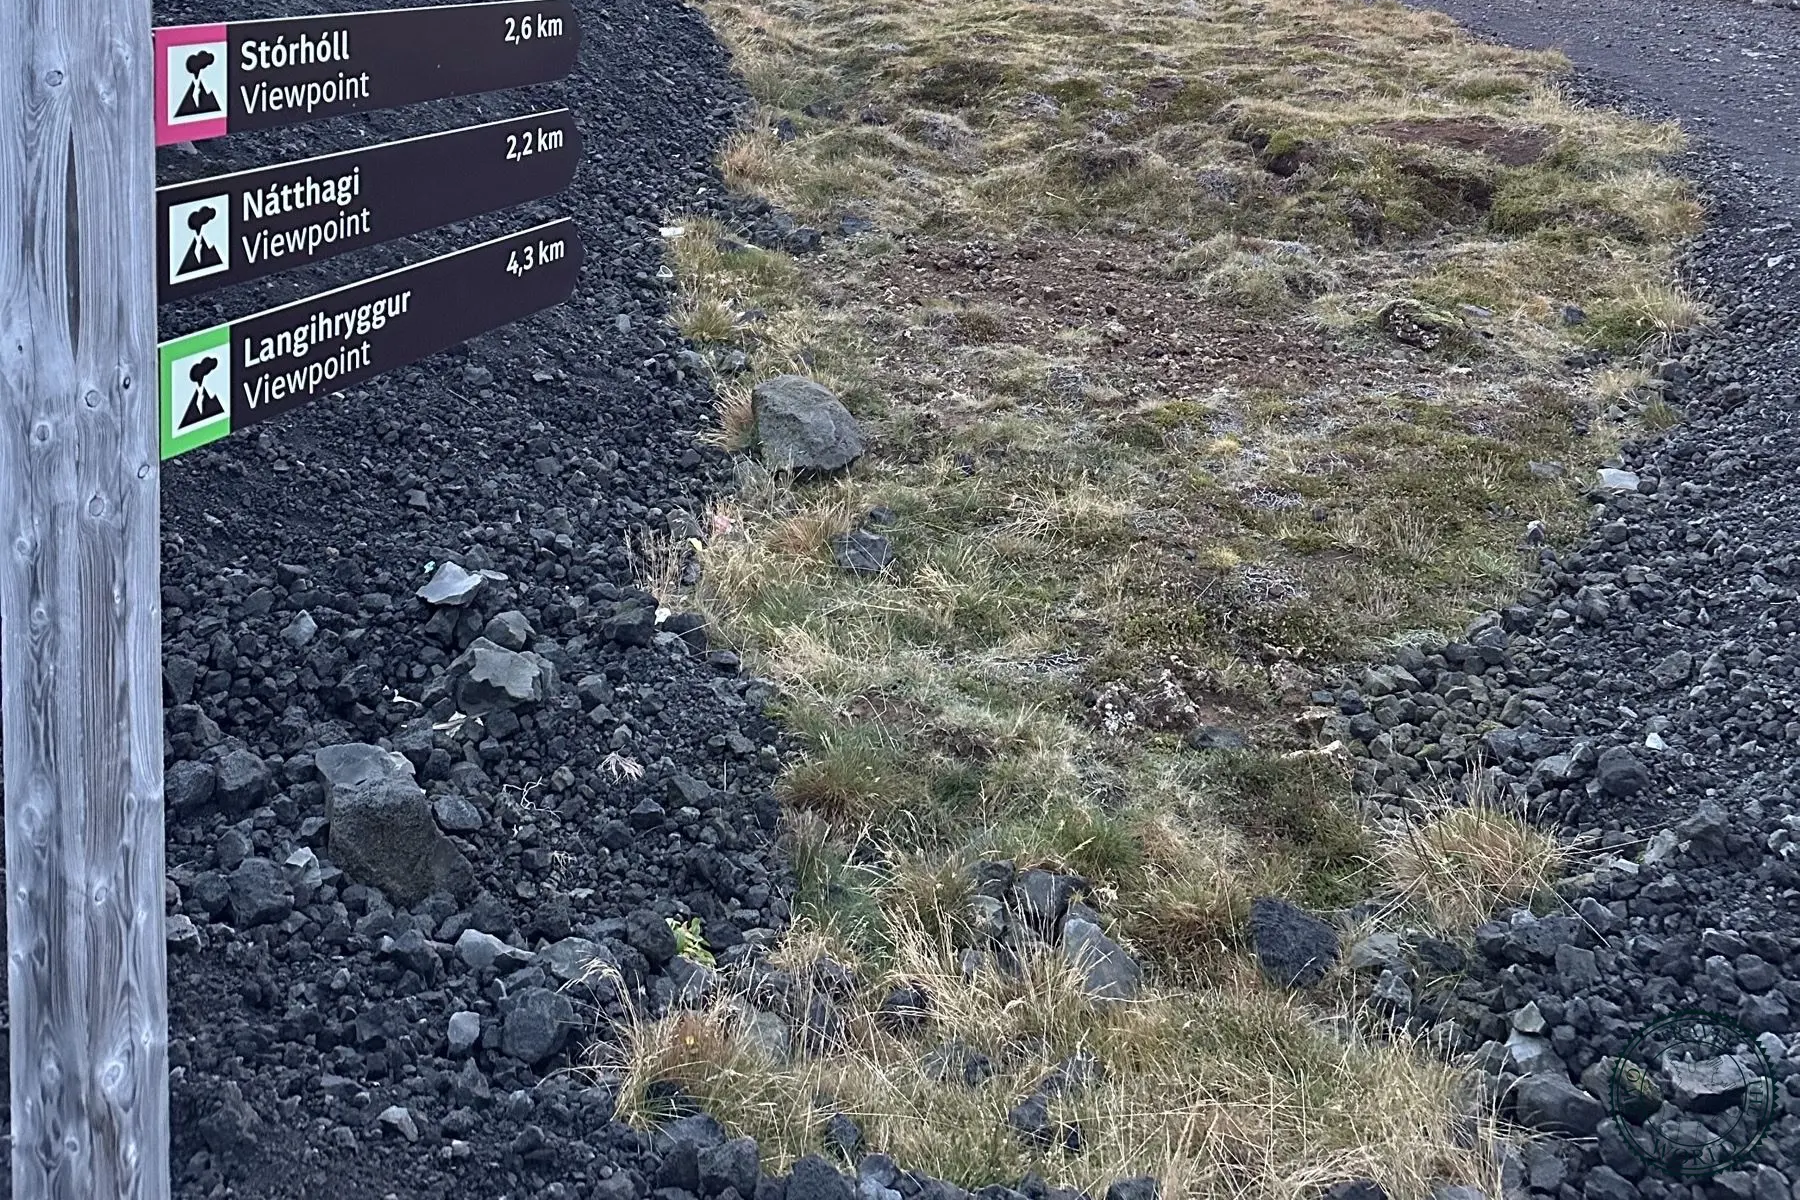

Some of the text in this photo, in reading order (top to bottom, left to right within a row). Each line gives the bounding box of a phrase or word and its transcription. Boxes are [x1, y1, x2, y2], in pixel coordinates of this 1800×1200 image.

[240, 30, 350, 72] Stórhóll
[504, 12, 563, 46] 2,6 km
[240, 71, 370, 115] Viewpoint
[506, 126, 563, 162] 2,2 km
[242, 166, 360, 222] Nátthagi
[242, 205, 371, 264] Viewpoint
[506, 239, 564, 278] 4,3 km
[244, 289, 412, 368] Langihryggur
[243, 339, 371, 410] Viewpoint
